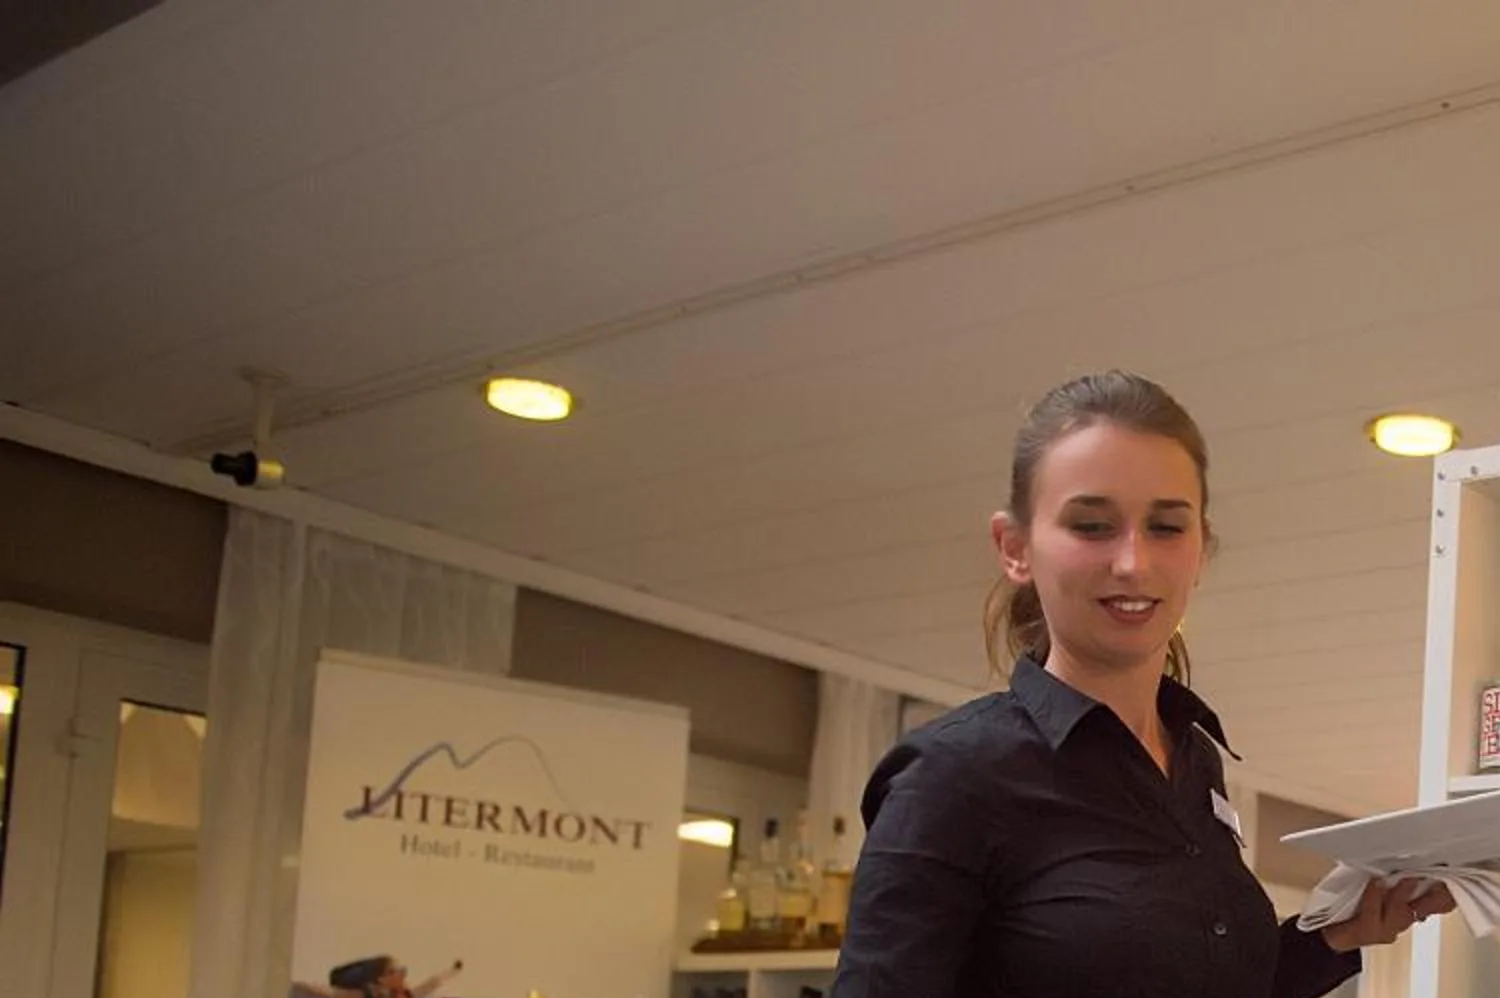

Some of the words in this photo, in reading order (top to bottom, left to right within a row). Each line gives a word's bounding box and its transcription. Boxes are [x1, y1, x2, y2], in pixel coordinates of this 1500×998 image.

[357, 785, 654, 851] LITERMONT
[401, 833, 461, 859] Hotel
[483, 842, 595, 875] Restaurant
